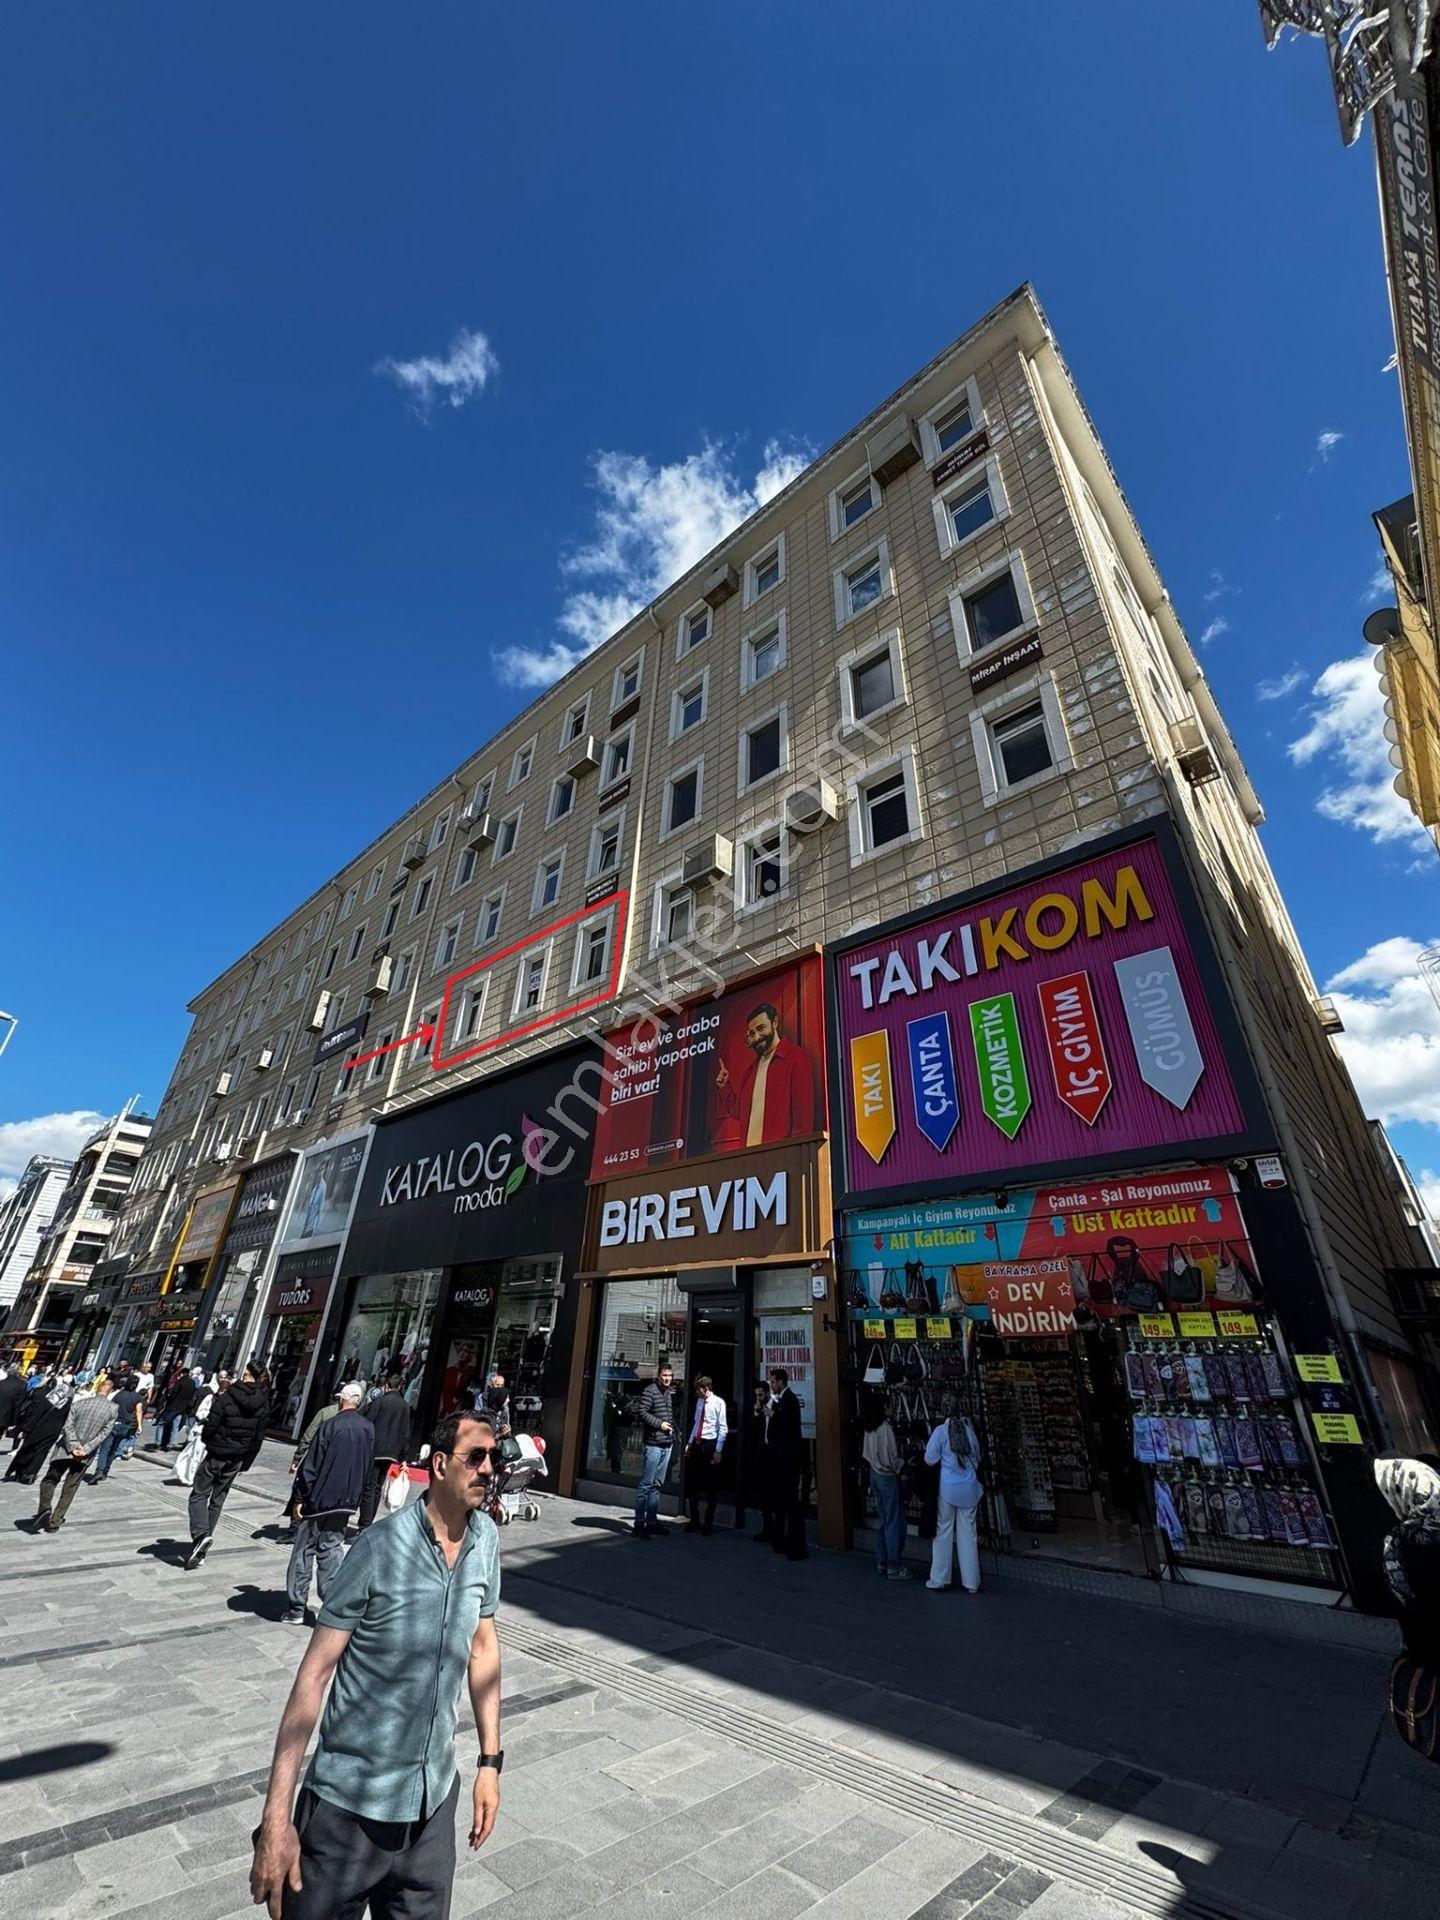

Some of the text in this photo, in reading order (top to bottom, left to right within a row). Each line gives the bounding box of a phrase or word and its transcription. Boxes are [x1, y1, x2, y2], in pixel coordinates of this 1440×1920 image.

[1411, 98, 1428, 178] Cafe
[1417, 192, 1431, 214] &
[1404, 249, 1428, 353] TUANA
[1003, 639, 1040, 666] İNŞAAT
[1135, 968, 1185, 1072] GÜMÜŞ
[615, 1013, 721, 1061] Sizi ev ve araba
[1053, 985, 1104, 1100] İÇ GİYİM
[612, 1036, 716, 1081] sahibi yapacak
[918, 1030, 953, 1117] ÇANTA
[979, 1002, 1018, 1119] KOZMETİK
[611, 1074, 660, 1102] biri var!
[863, 1062, 884, 1118] TAKI
[379, 1132, 513, 1206] KATALOG
[603, 1148, 640, 1165] 444 23 53
[453, 1183, 504, 1214] moda
[1049, 1194, 1088, 1212] Çanta
[1101, 1188, 1124, 1207] Şal
[1128, 1178, 1212, 1199] Reyonumuz
[857, 1213, 911, 1231] Kampanyalı
[913, 1210, 923, 1226] İç
[925, 1209, 953, 1225] Giyim
[1072, 1204, 1197, 1234] Üst Kattadır
[890, 1227, 976, 1250] Alt Kattadır
[984, 1259, 1068, 1277] BAYRAMA ÖZEL
[279, 1289, 311, 1307] TUDORS
[455, 1289, 488, 1302] KATALOG
[1007, 1281, 1045, 1302] DEV
[991, 1305, 1078, 1333] İNDİRİM
[1222, 1321, 1243, 1335] 149
